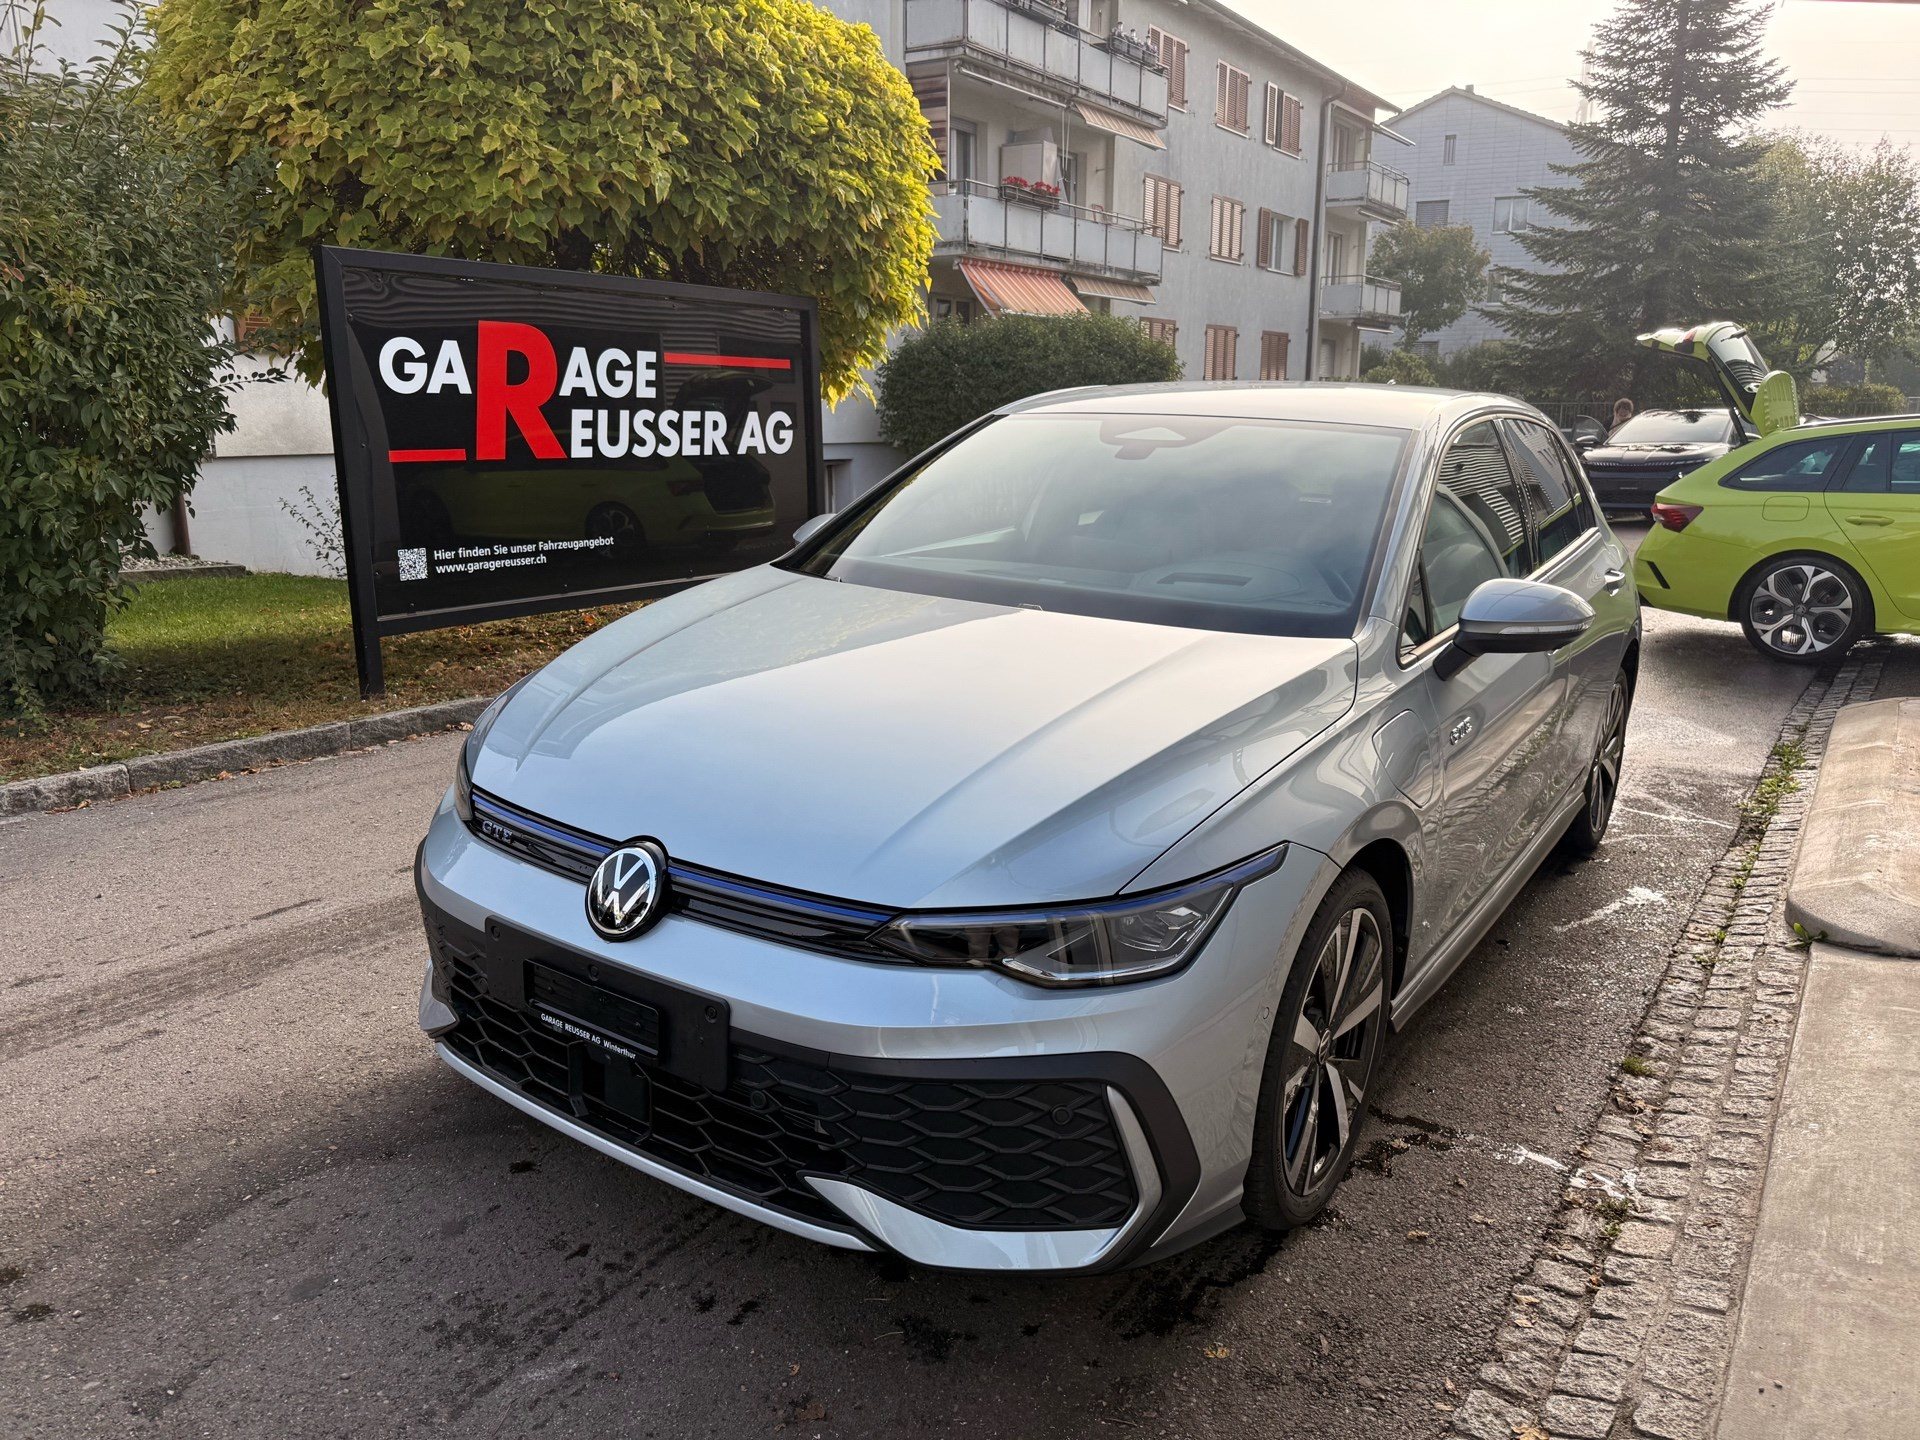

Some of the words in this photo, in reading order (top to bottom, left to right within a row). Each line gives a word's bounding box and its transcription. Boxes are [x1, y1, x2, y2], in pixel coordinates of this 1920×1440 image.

[737, 411, 793, 455] AG
[434, 549, 456, 561] Hier
[458, 547, 491, 559] finden
[493, 544, 508, 555] Sie
[510, 543, 536, 553] unser
[538, 536, 614, 551] Fahrzeugangebot
[436, 554, 547, 573] www.garagereusser.ch
[482, 820, 512, 843] GTE
[541, 1013, 563, 1029] GARAGE
[564, 1023, 591, 1040] REUSSER
[591, 1033, 601, 1045] AG
[603, 1039, 636, 1060] Winterthur
